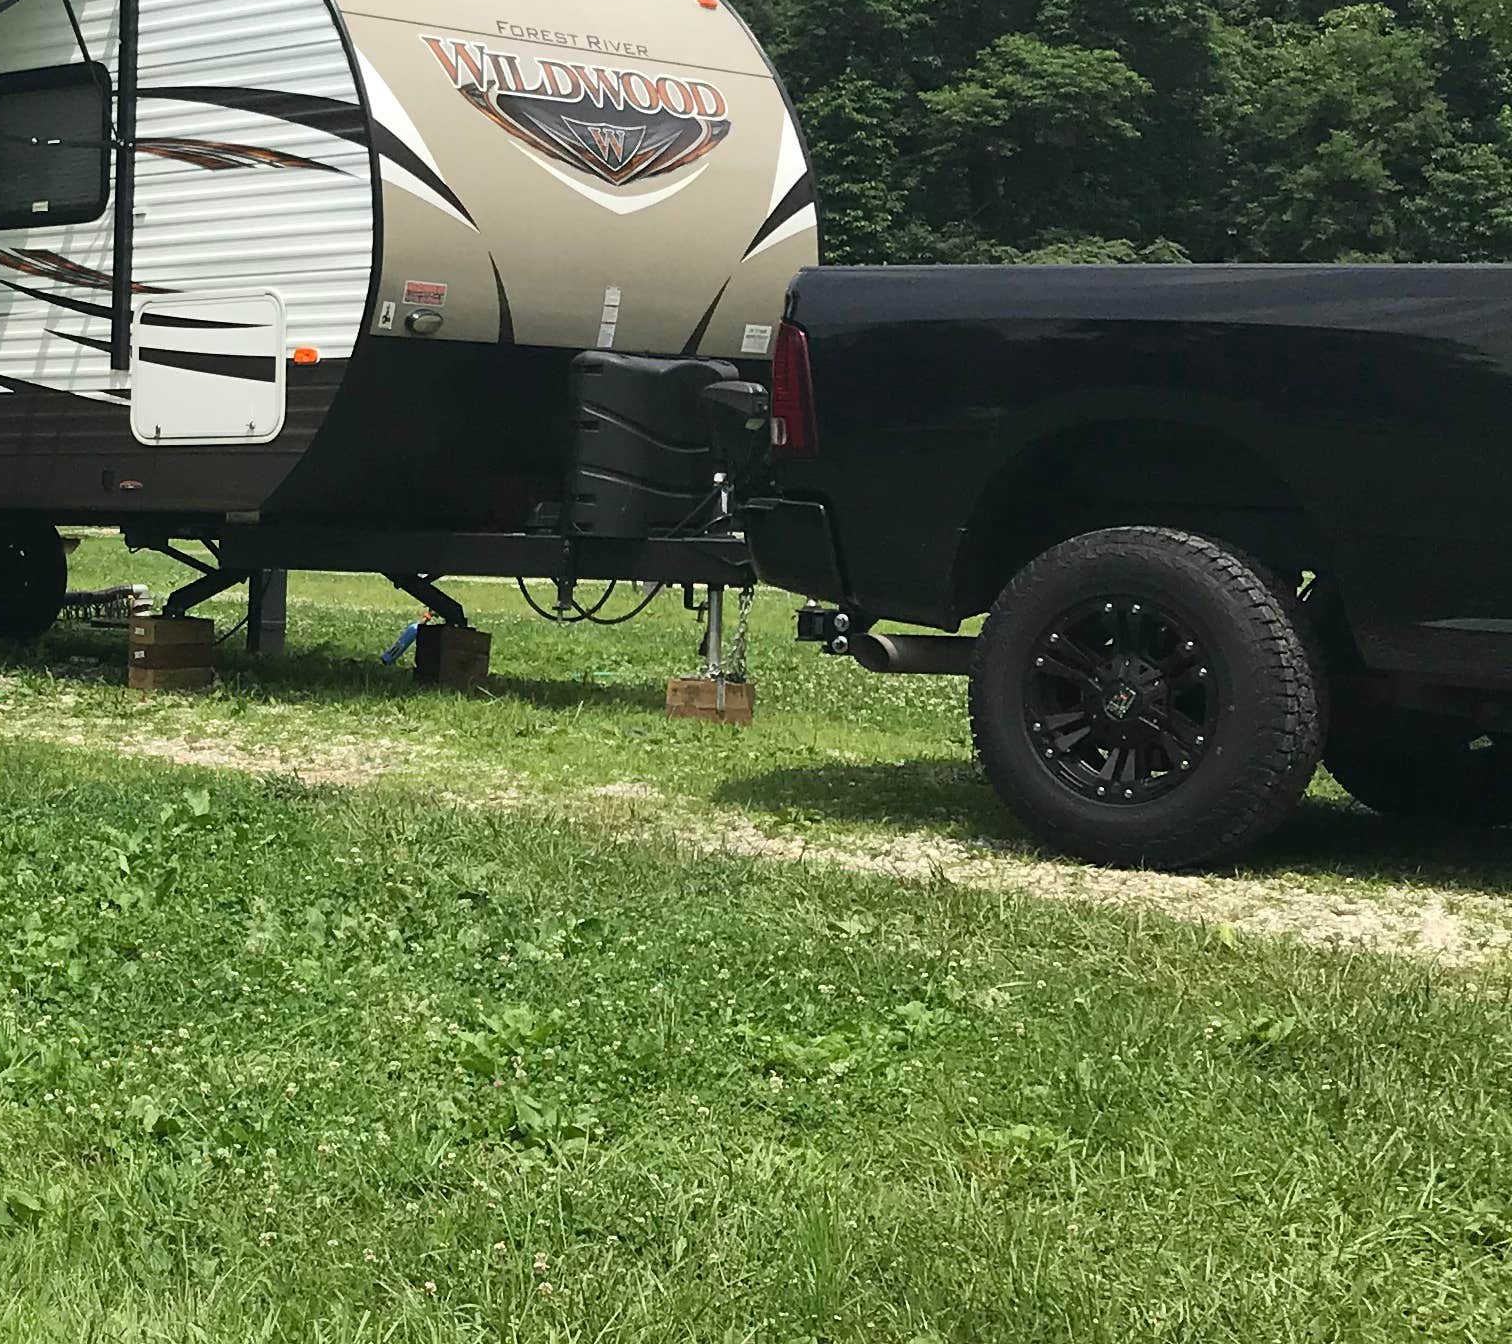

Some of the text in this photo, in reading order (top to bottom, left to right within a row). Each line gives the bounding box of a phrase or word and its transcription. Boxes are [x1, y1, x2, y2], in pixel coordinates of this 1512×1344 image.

[495, 20, 649, 57] FOREST RIVER
[420, 34, 727, 119] WILDWOOD
[588, 126, 626, 163] W
